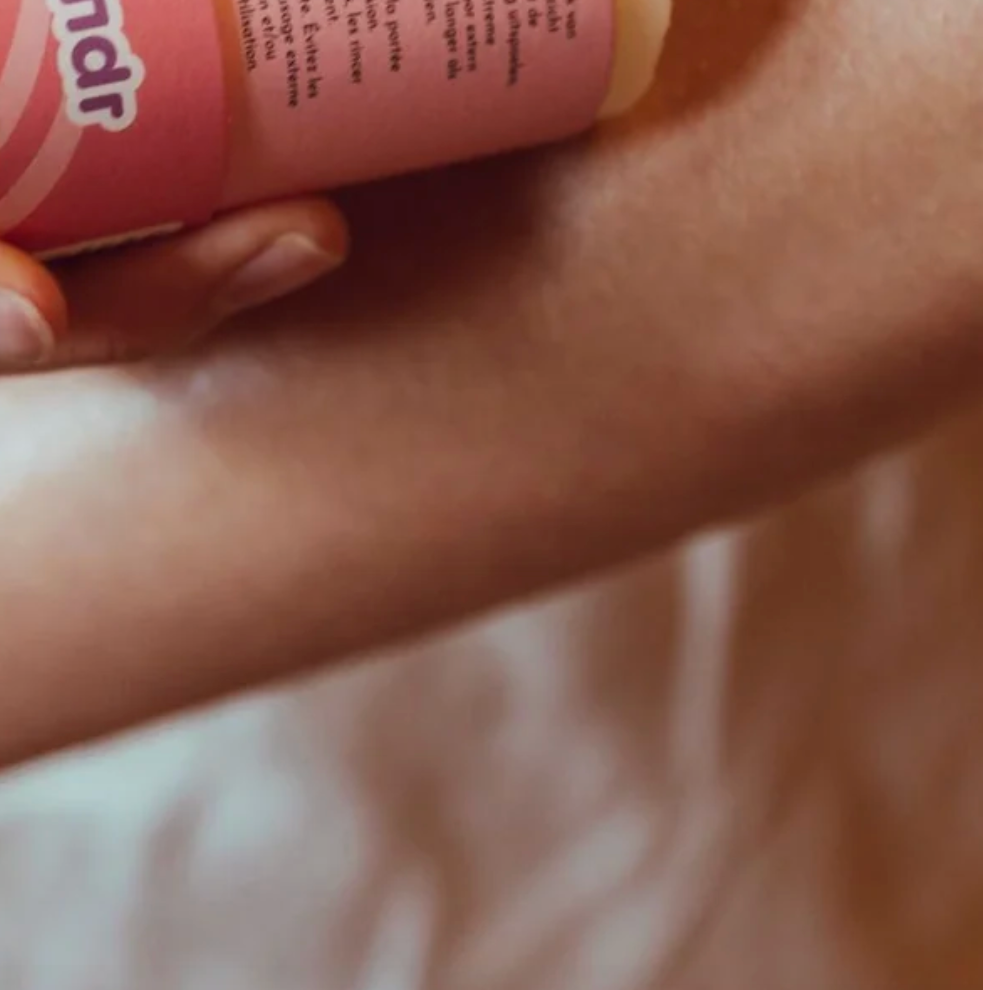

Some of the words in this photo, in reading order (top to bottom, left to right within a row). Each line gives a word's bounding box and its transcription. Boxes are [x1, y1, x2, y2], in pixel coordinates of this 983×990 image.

[260, 15, 277, 61] et/ou
[346, 10, 360, 35] les
[444, 0, 459, 54] langer
[528, 5, 541, 28] de
[302, 20, 319, 74] Évitez
[352, 39, 363, 85] rincer
[384, 19, 401, 73] portée
[447, 57, 462, 80] als
[465, 22, 478, 72] extern
[284, 49, 300, 108] externe
[307, 76, 322, 99] les
